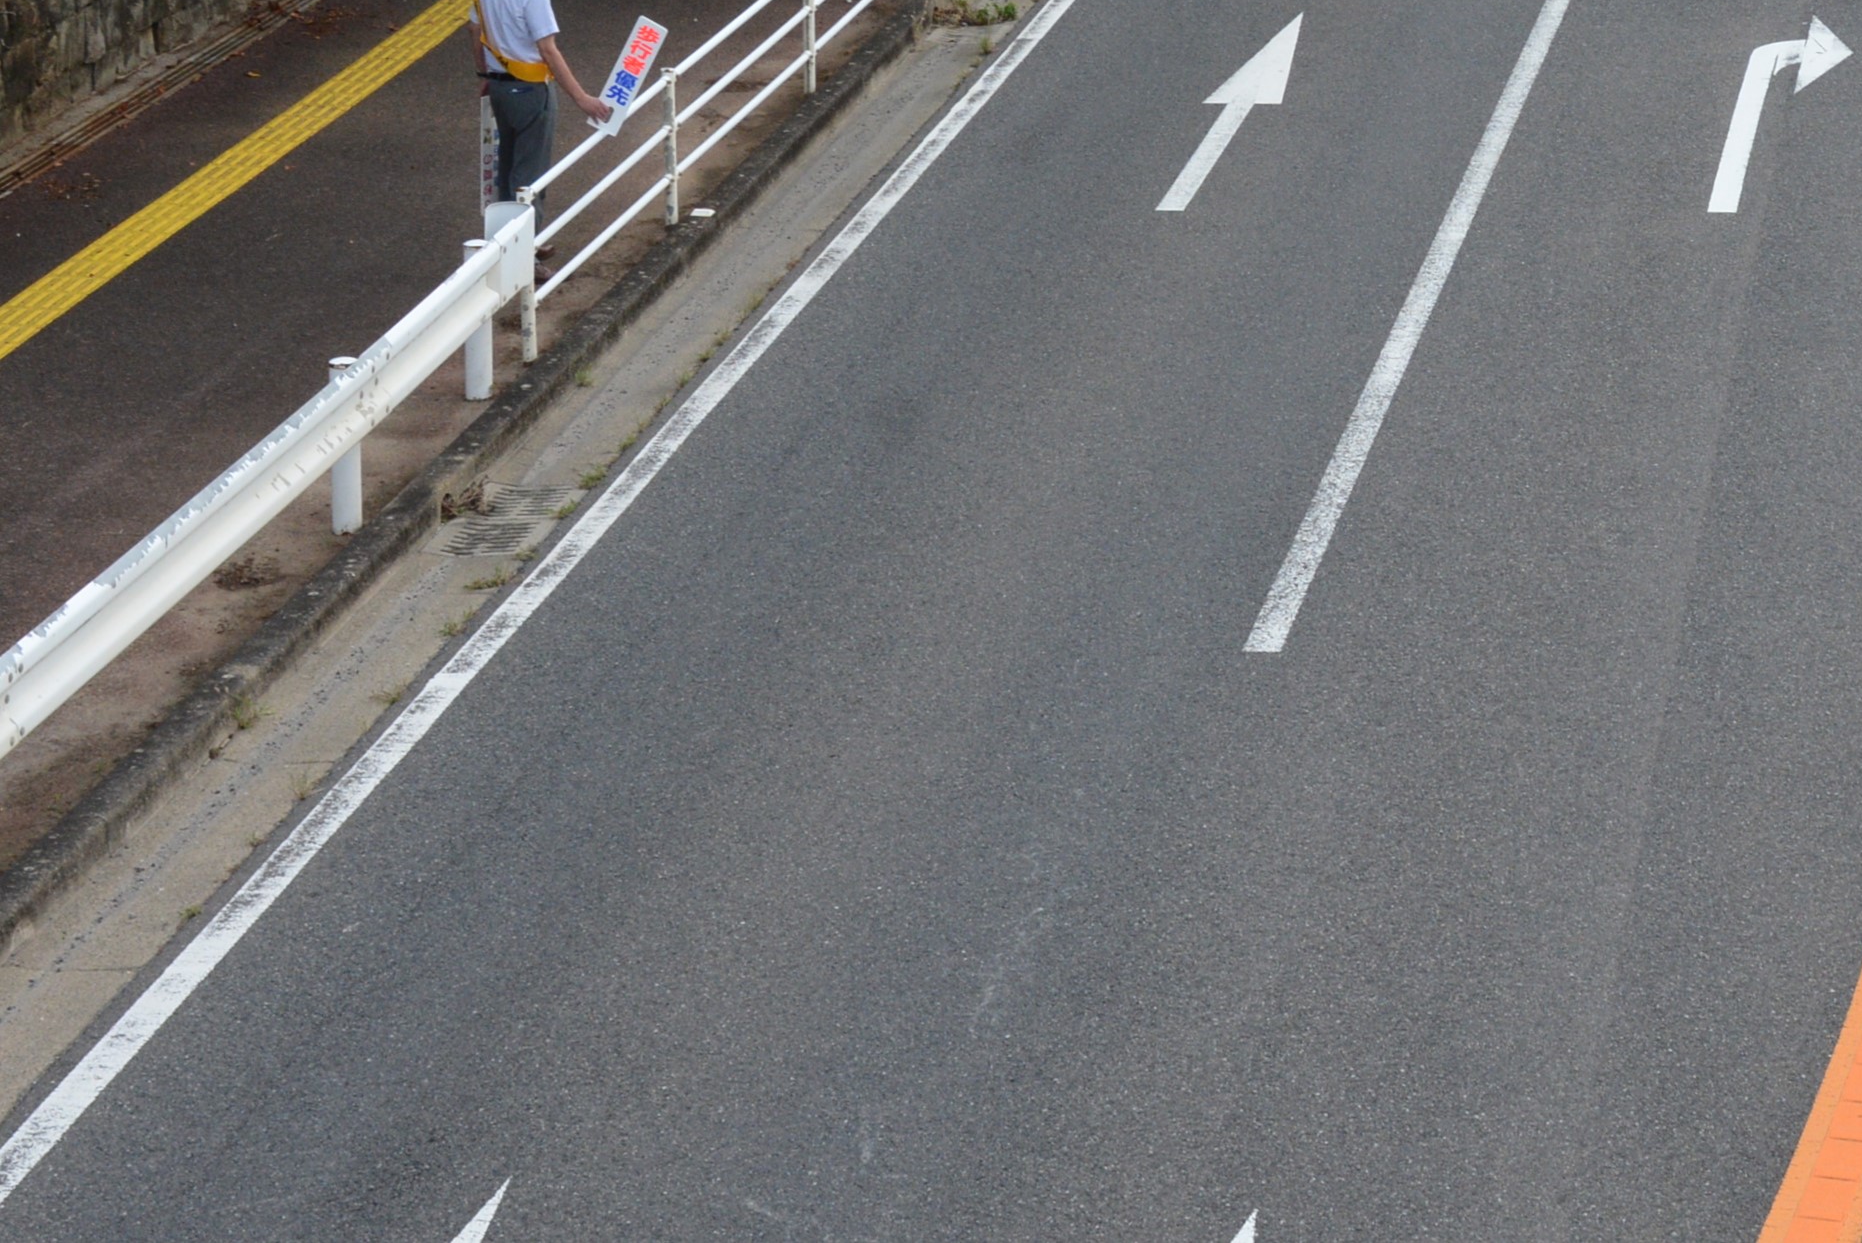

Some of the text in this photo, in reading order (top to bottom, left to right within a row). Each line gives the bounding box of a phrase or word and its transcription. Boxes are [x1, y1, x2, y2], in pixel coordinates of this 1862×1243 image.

[605, 24, 661, 107] 歩行者優先
